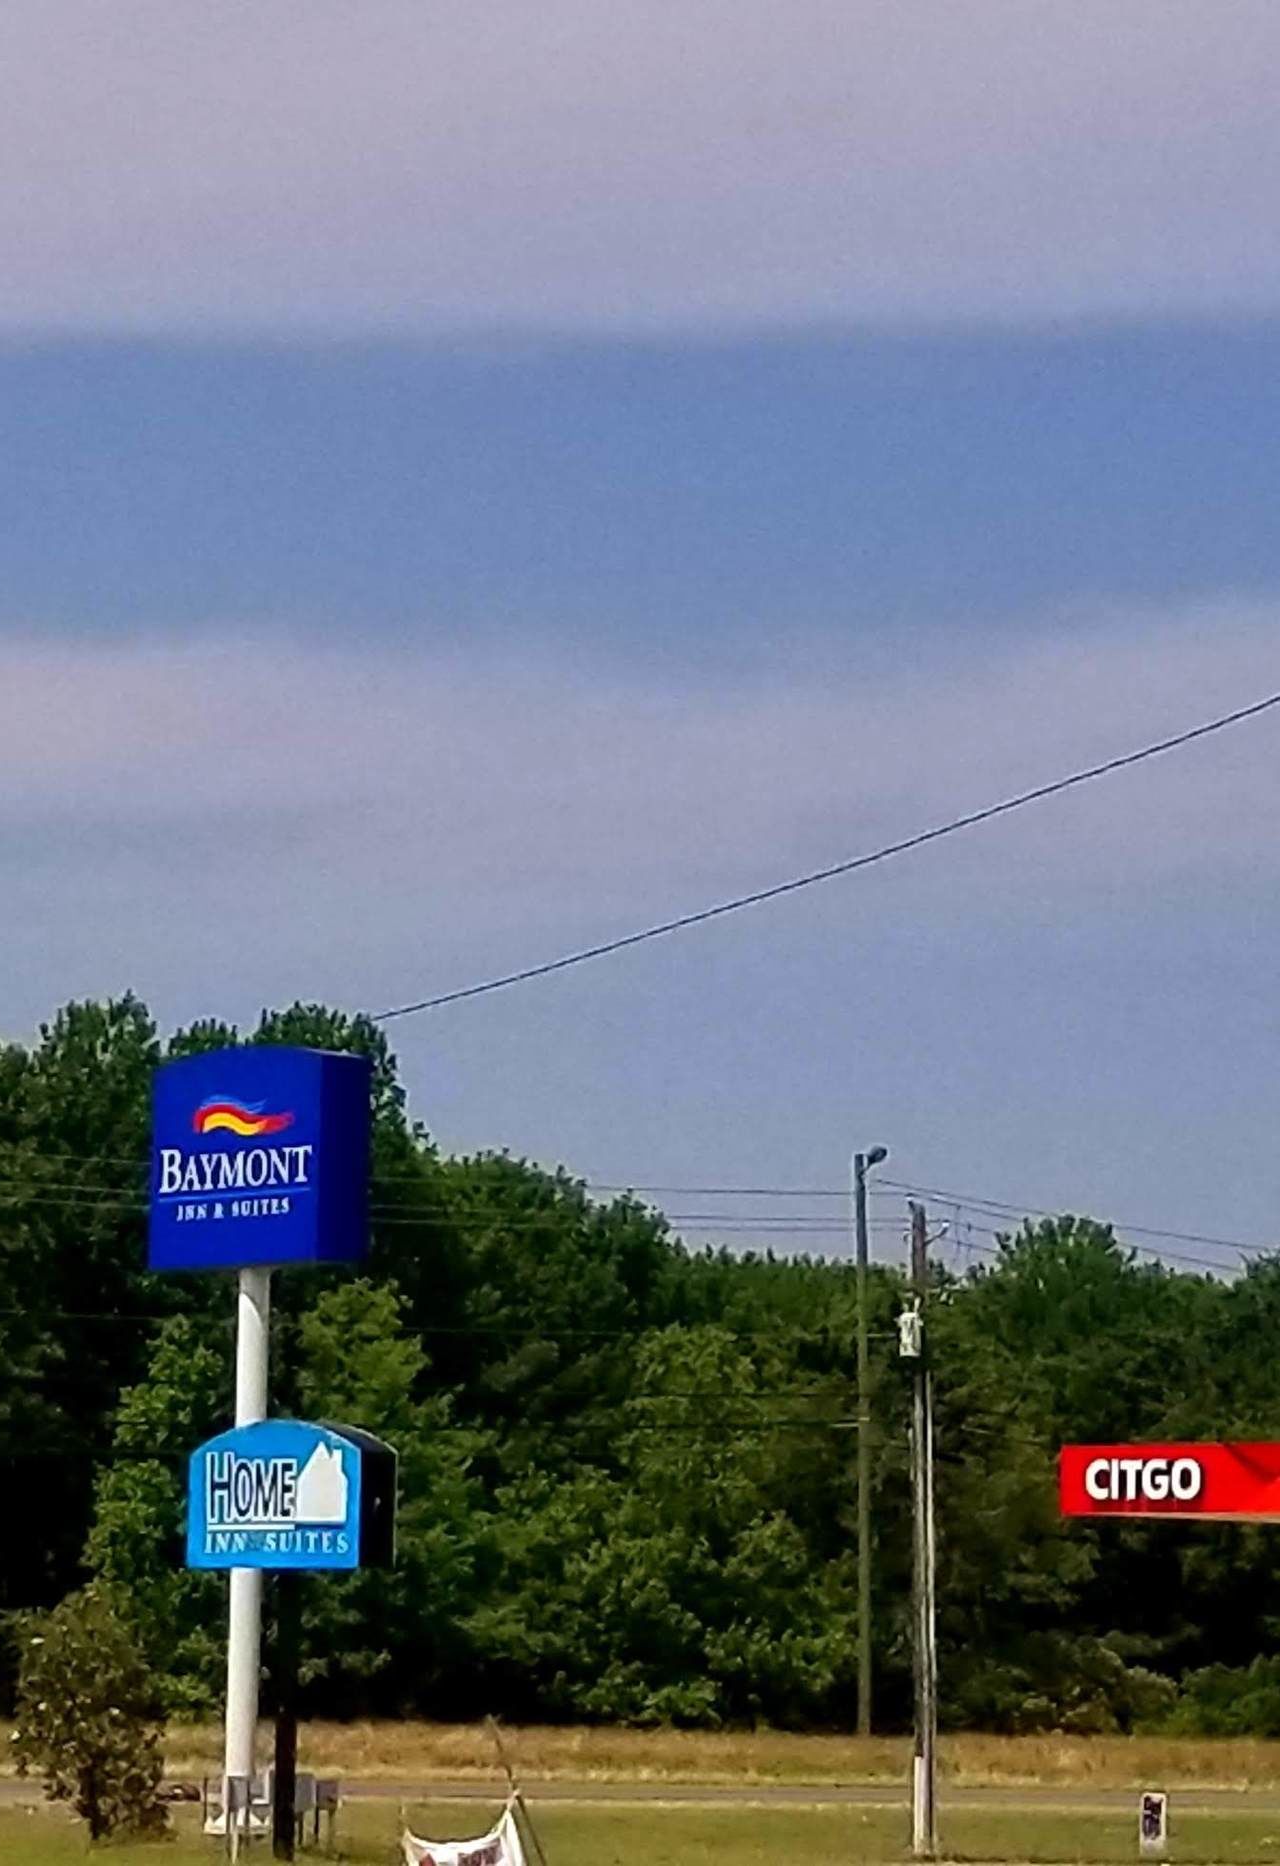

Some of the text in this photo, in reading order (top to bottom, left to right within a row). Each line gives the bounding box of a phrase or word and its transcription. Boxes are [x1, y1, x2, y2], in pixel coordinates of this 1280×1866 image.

[159, 1145, 313, 1194] BAYMONT
[176, 1204, 208, 1222] INN
[231, 1196, 290, 1217] SUITES
[206, 1451, 297, 1524] HOME
[1085, 1457, 1201, 1501] CITGO
[204, 1532, 248, 1554] INN
[263, 1530, 350, 1554] SUITES
